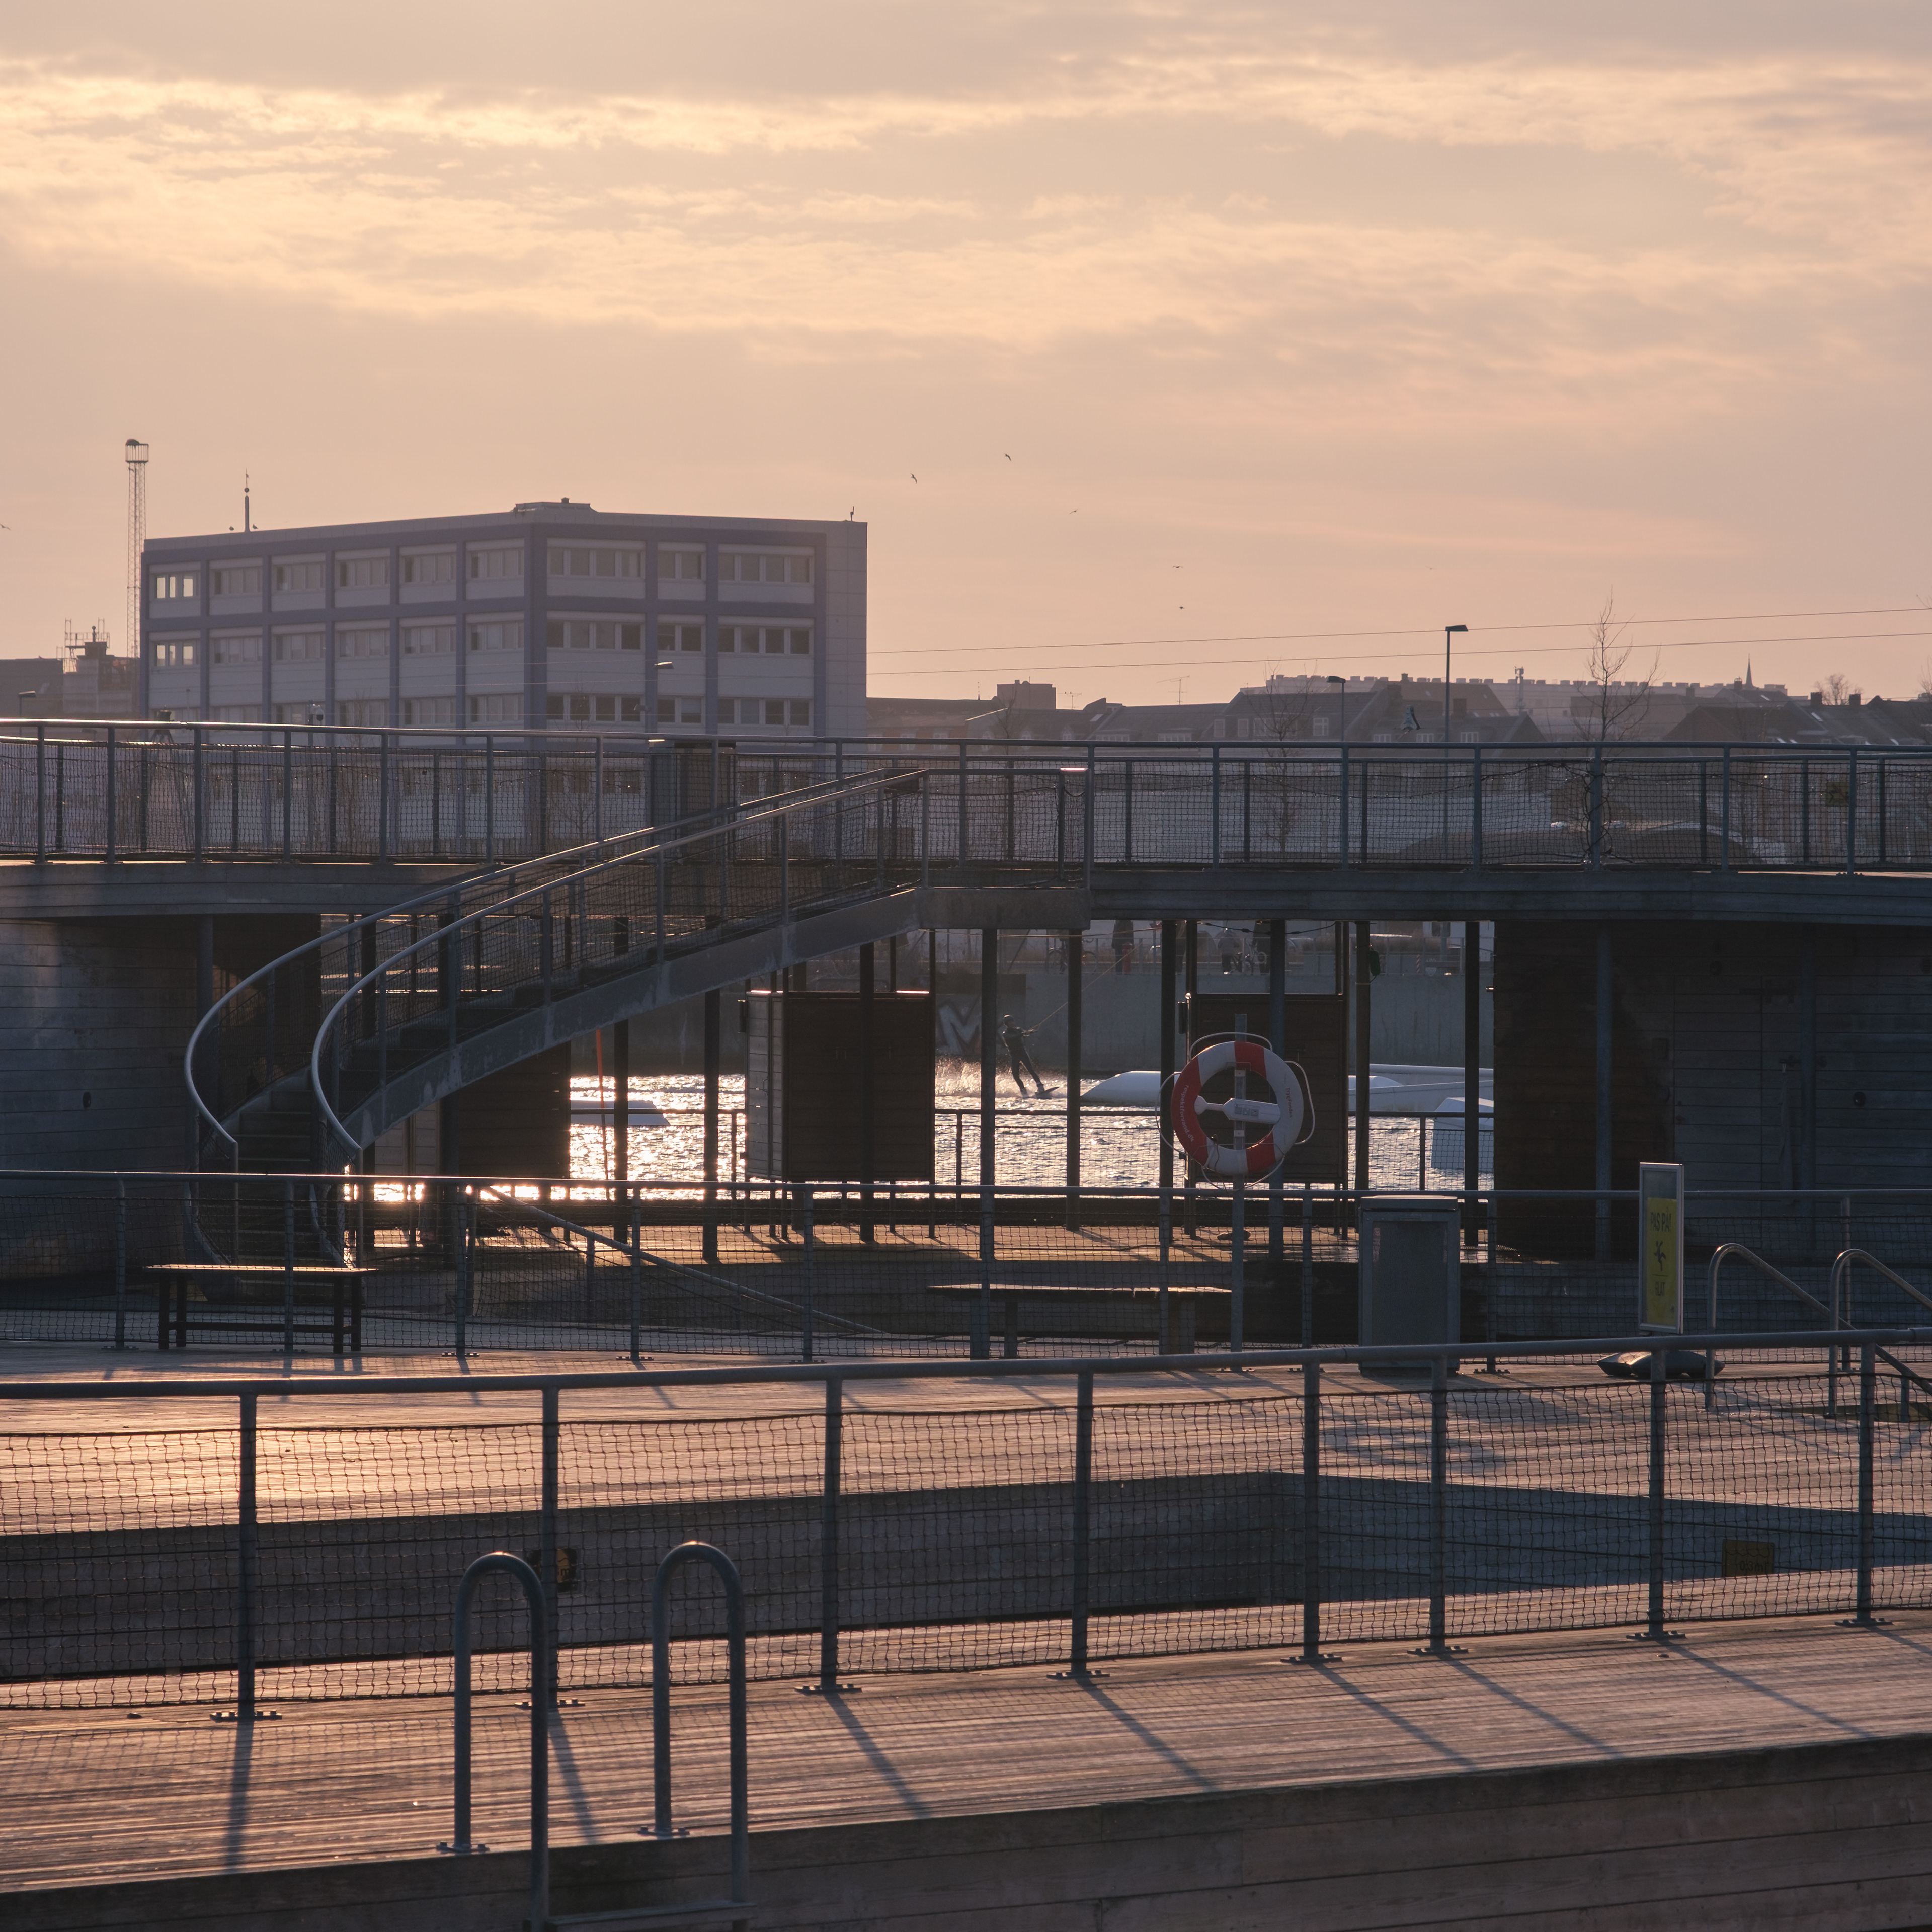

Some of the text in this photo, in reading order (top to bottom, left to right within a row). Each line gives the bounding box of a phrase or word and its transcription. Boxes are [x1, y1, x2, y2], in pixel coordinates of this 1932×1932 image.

[1180, 1085, 1194, 1142] respektforvand.dk
[1650, 1206, 1672, 1232] PAS PÅ!
[1655, 1281, 1665, 1297] GLAT
